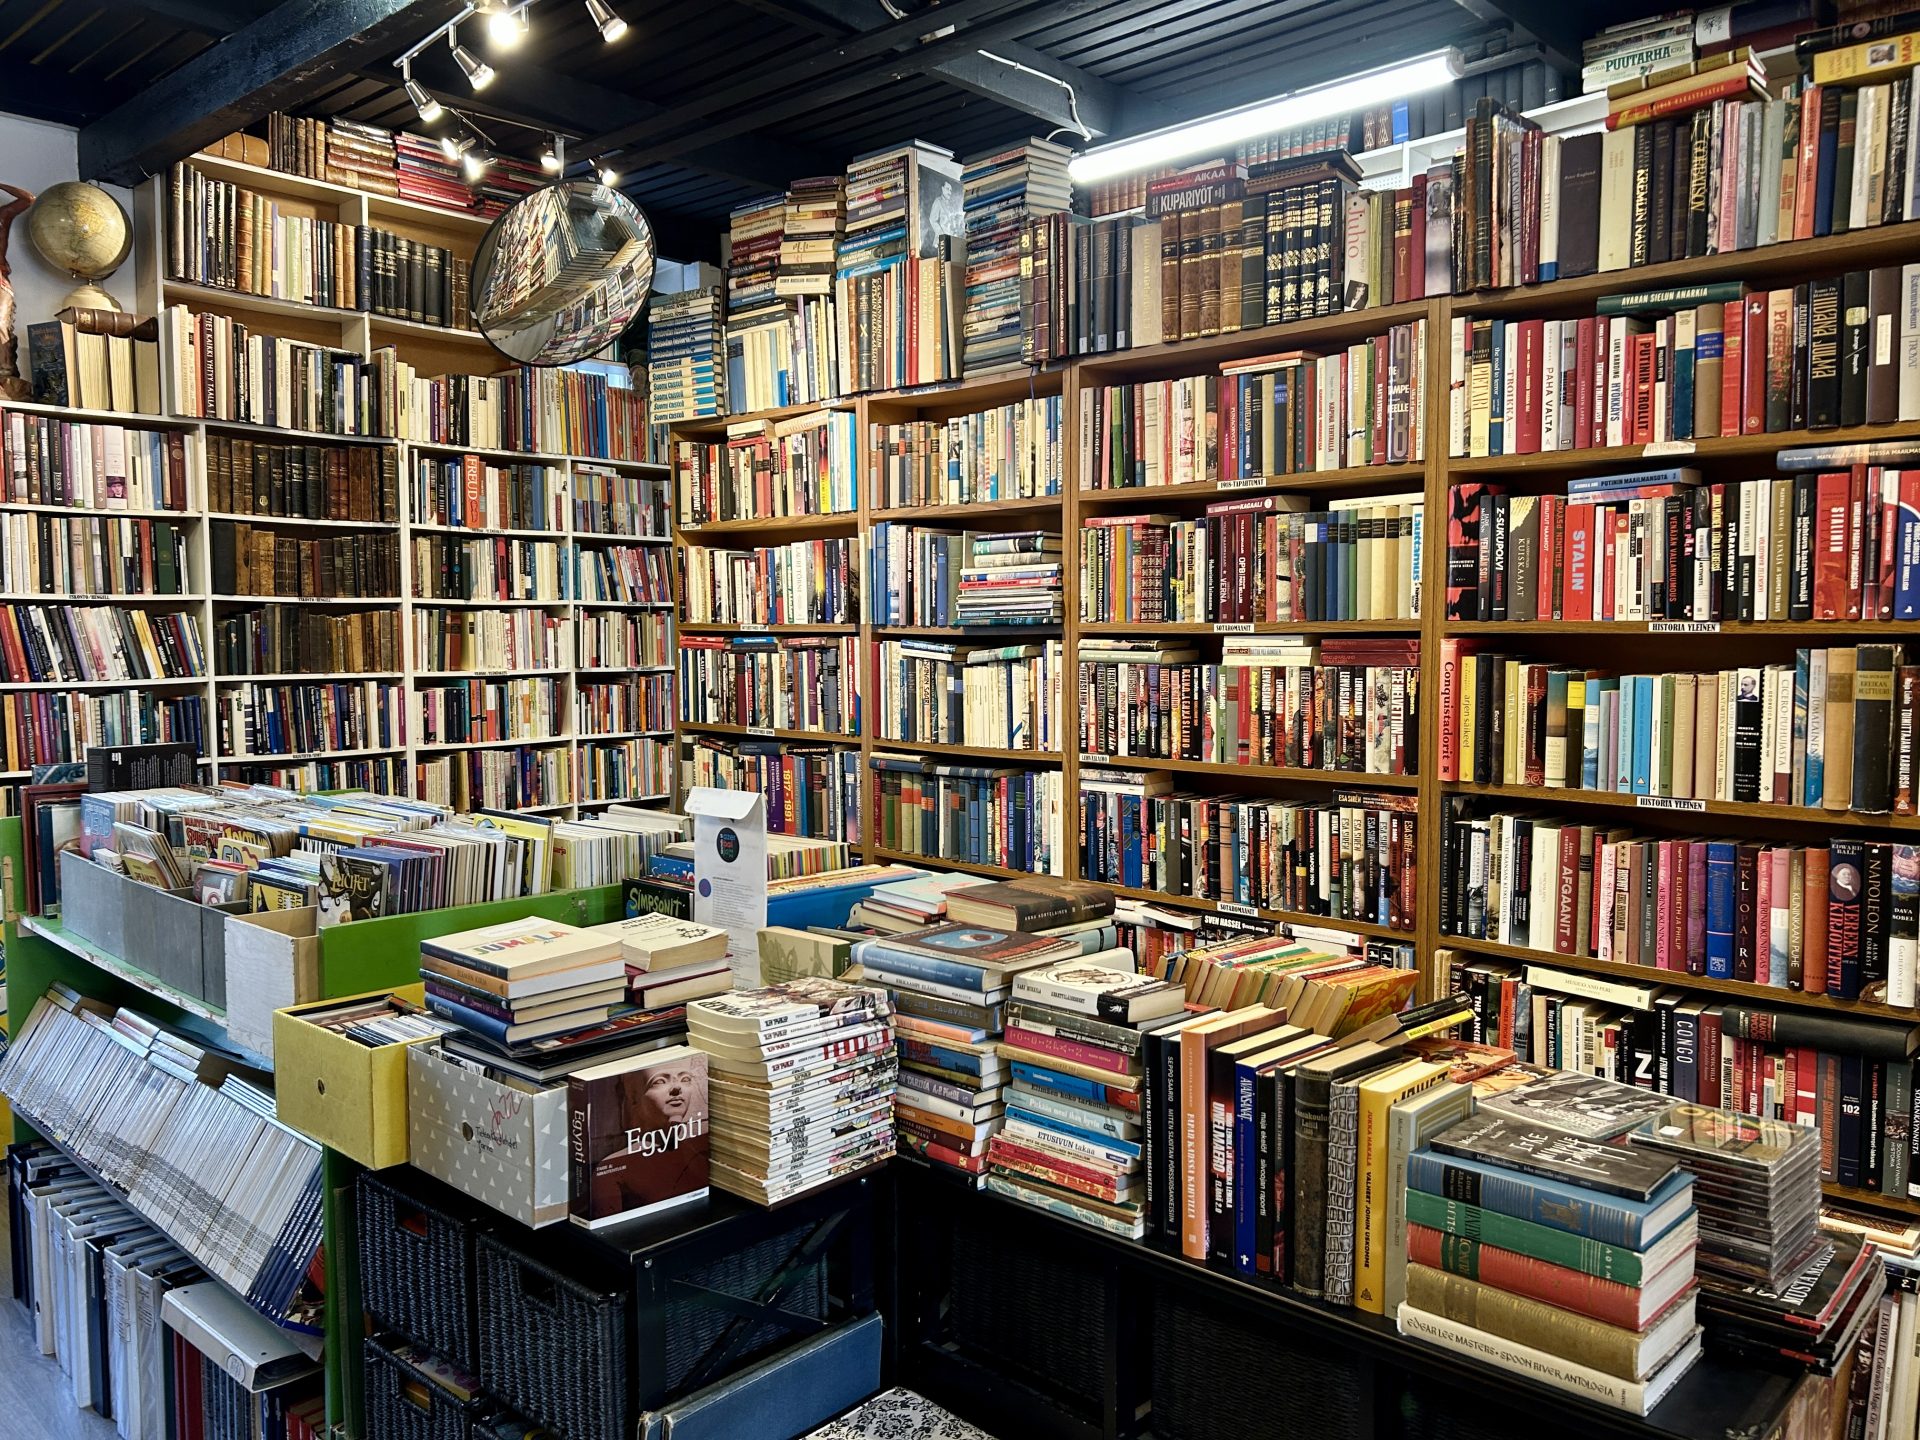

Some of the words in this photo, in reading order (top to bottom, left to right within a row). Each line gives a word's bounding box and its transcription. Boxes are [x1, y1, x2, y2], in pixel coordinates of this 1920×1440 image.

[1605, 46, 1671, 72] PUUTARHA
[1195, 168, 1226, 183] AIKAA
[1636, 168, 1648, 221] KREMLIN
[1160, 185, 1213, 212] KUPARIYÖT
[1347, 206, 1366, 258] Juho
[1633, 223, 1646, 264] NAISET
[1621, 296, 1648, 306] AVARAN
[1650, 292, 1675, 303] SIELUN
[1676, 287, 1708, 300] ANARKIA
[1640, 342, 1651, 384] PUTININ
[1544, 400, 1553, 433] VALTA
[1638, 390, 1649, 431] TROLLIT
[467, 458, 478, 500] FREUD
[1495, 507, 1505, 571] Z-SUKUPOLVI
[1830, 507, 1845, 552] STALININ
[1517, 538, 1525, 597] KUISKAAJAT
[1571, 529, 1586, 592] STALIN
[1652, 623, 1686, 633] HISTORIA
[1687, 623, 1716, 632] YLEINEN
[1441, 661, 1455, 760] Conquistadorit
[1463, 695, 1471, 715] arjen
[1900, 708, 1912, 753] TOIMITTAJANA
[783, 769, 792, 790] 1917
[1899, 754, 1910, 789] KABULISSA
[783, 800, 792, 822] 1991
[1640, 797, 1674, 809] HISTORIA
[1675, 800, 1702, 811] YLEINEN
[1560, 866, 1574, 936] AFGAANIT
[1867, 859, 1882, 934] NAPOLEON
[1894, 907, 1914, 915] DAVA
[1792, 892, 1801, 944] KUNINKAAN
[1844, 904, 1860, 958] VEREEN
[470, 929, 569, 956] JUMALA
[1790, 945, 1800, 968] PUHE
[1828, 902, 1844, 990] KIRJOITETTU
[1474, 995, 1482, 1012] THE
[1677, 1020, 1693, 1064] CONGO
[1842, 1104, 1860, 1115] 102
[572, 1110, 586, 1164] Egypti
[624, 1112, 703, 1157] Egypti
[1037, 1131, 1073, 1149] ETUSIVUN
[1074, 1143, 1095, 1156] takaa
[1212, 1101, 1225, 1172] UNELMAERO
[1438, 1327, 1454, 1342] LEE
[1455, 1334, 1495, 1356] MASTERS
[1501, 1350, 1532, 1369] SPOON
[1533, 1359, 1562, 1380] RIVER
[1564, 1369, 1614, 1398] ANTOLOGIA
